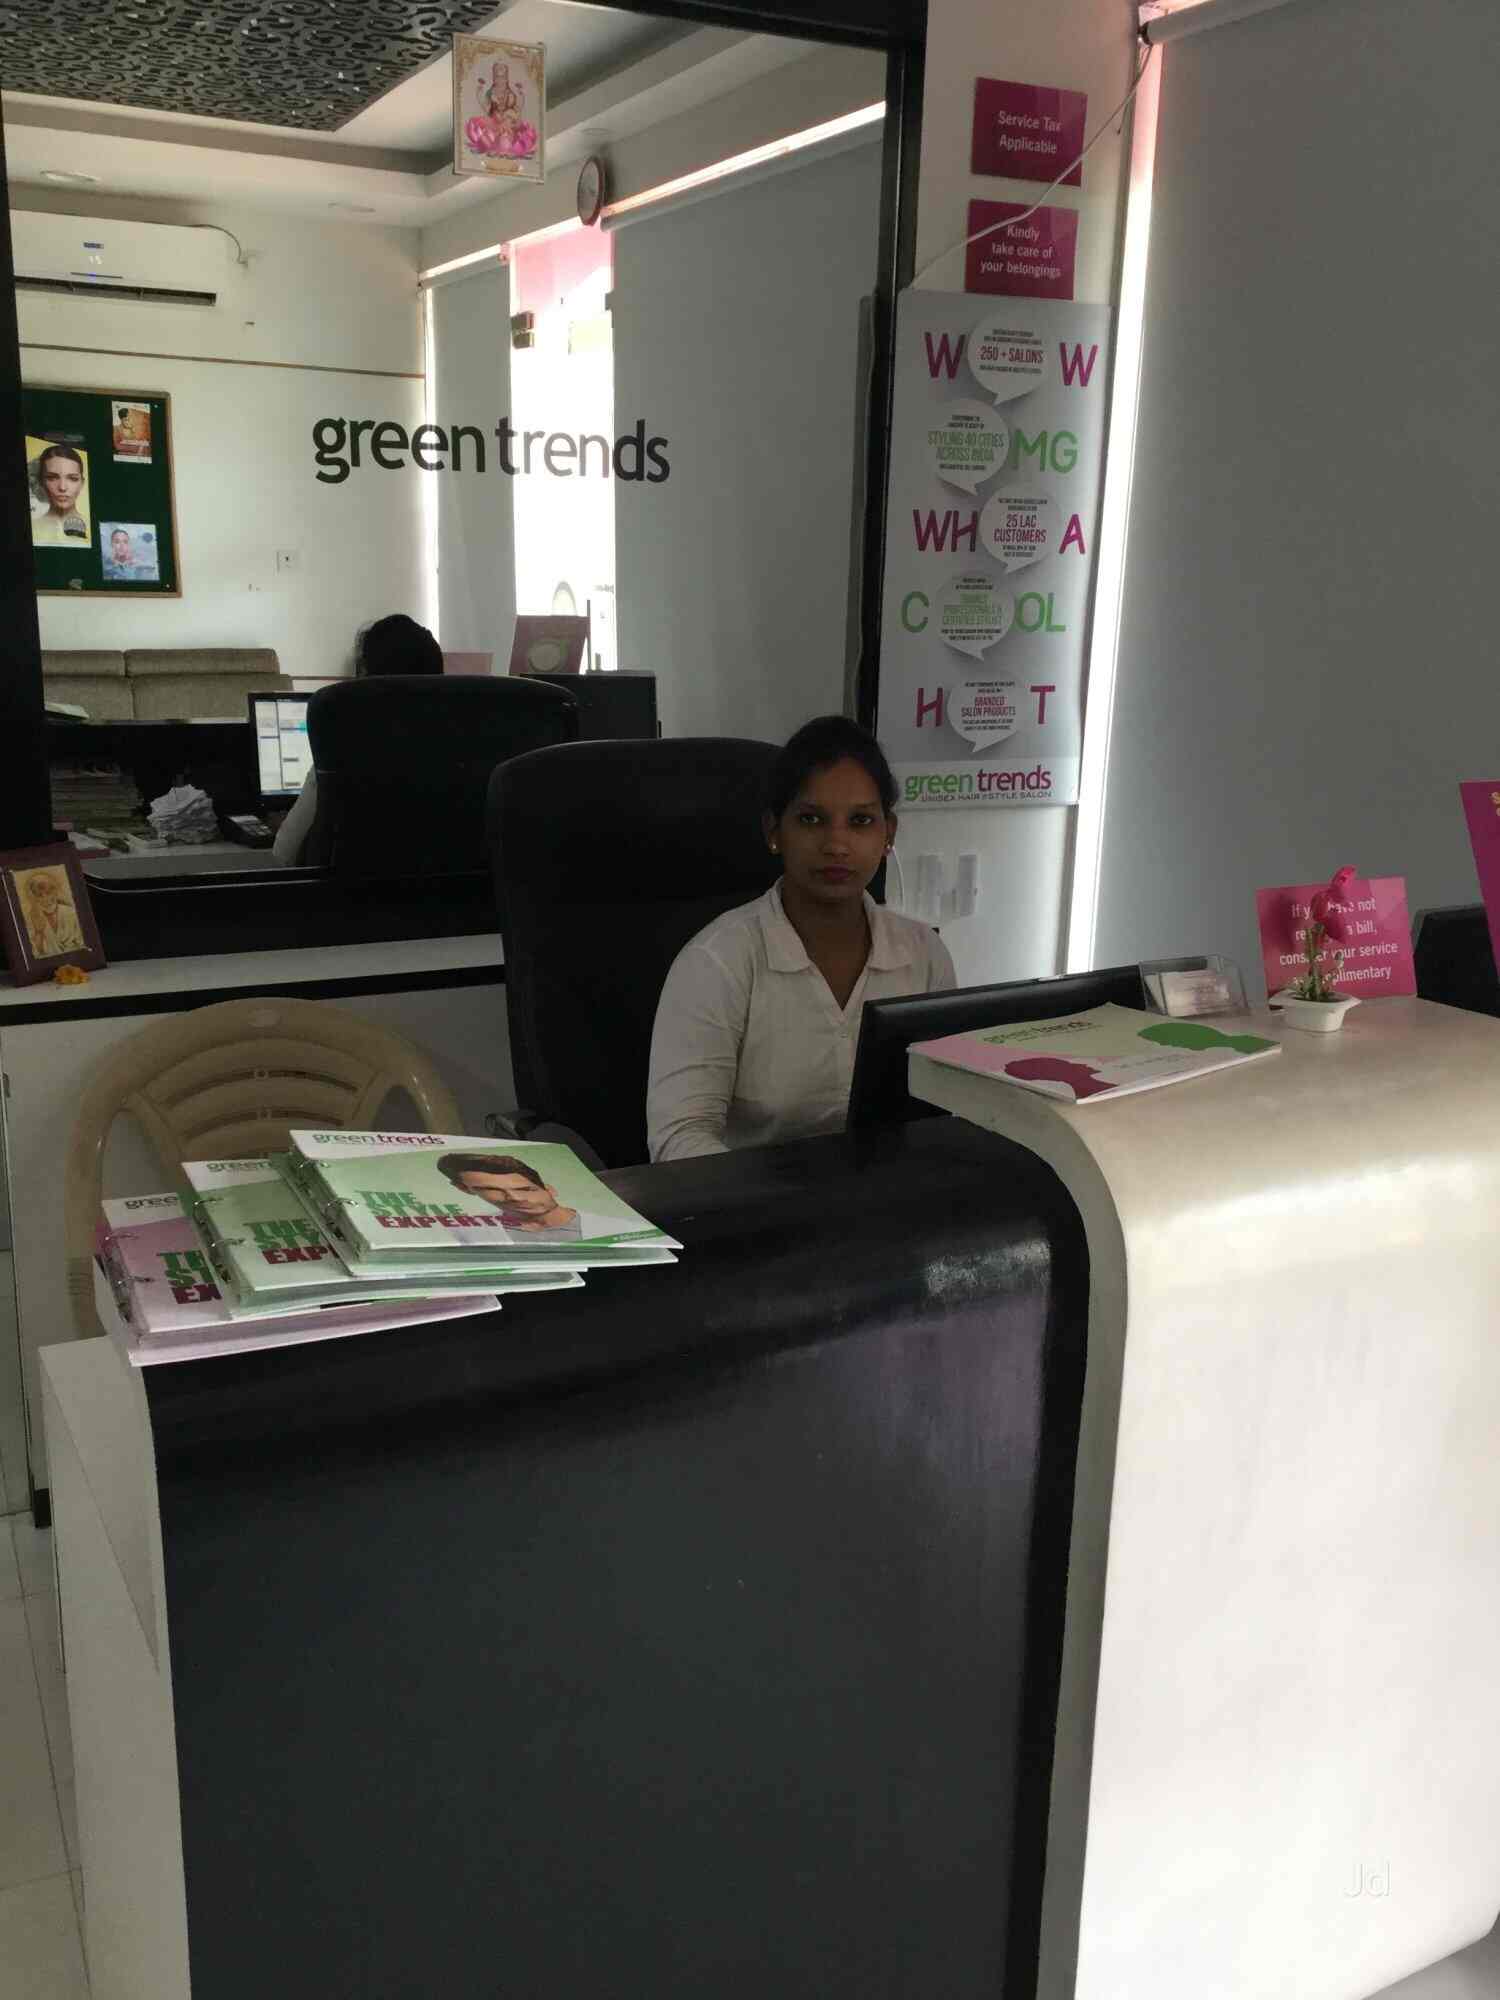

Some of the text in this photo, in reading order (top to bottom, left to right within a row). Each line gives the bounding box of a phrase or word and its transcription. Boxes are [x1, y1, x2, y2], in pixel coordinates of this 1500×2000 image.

[998, 111, 1062, 132] Service Tax
[999, 133, 1057, 154] Applicable
[1007, 225, 1040, 241] Kindly
[992, 242, 1054, 258] take care of
[980, 259, 1061, 280] your belongings
[1008, 347, 1044, 364] SALONS
[312, 415, 671, 484] green trends
[1006, 513, 1037, 528] 25 LAC
[993, 528, 1047, 544] CUSTOMERS
[905, 764, 1051, 800] green trends
[1020, 790, 1051, 799] SALON
[1358, 897, 1376, 911] not
[1356, 921, 1378, 935] bill,
[1279, 952, 1327, 966] conser
[1359, 941, 1398, 957] service
[312, 1133, 445, 1146] green trends
[375, 1215, 524, 1229] EXPERTS
